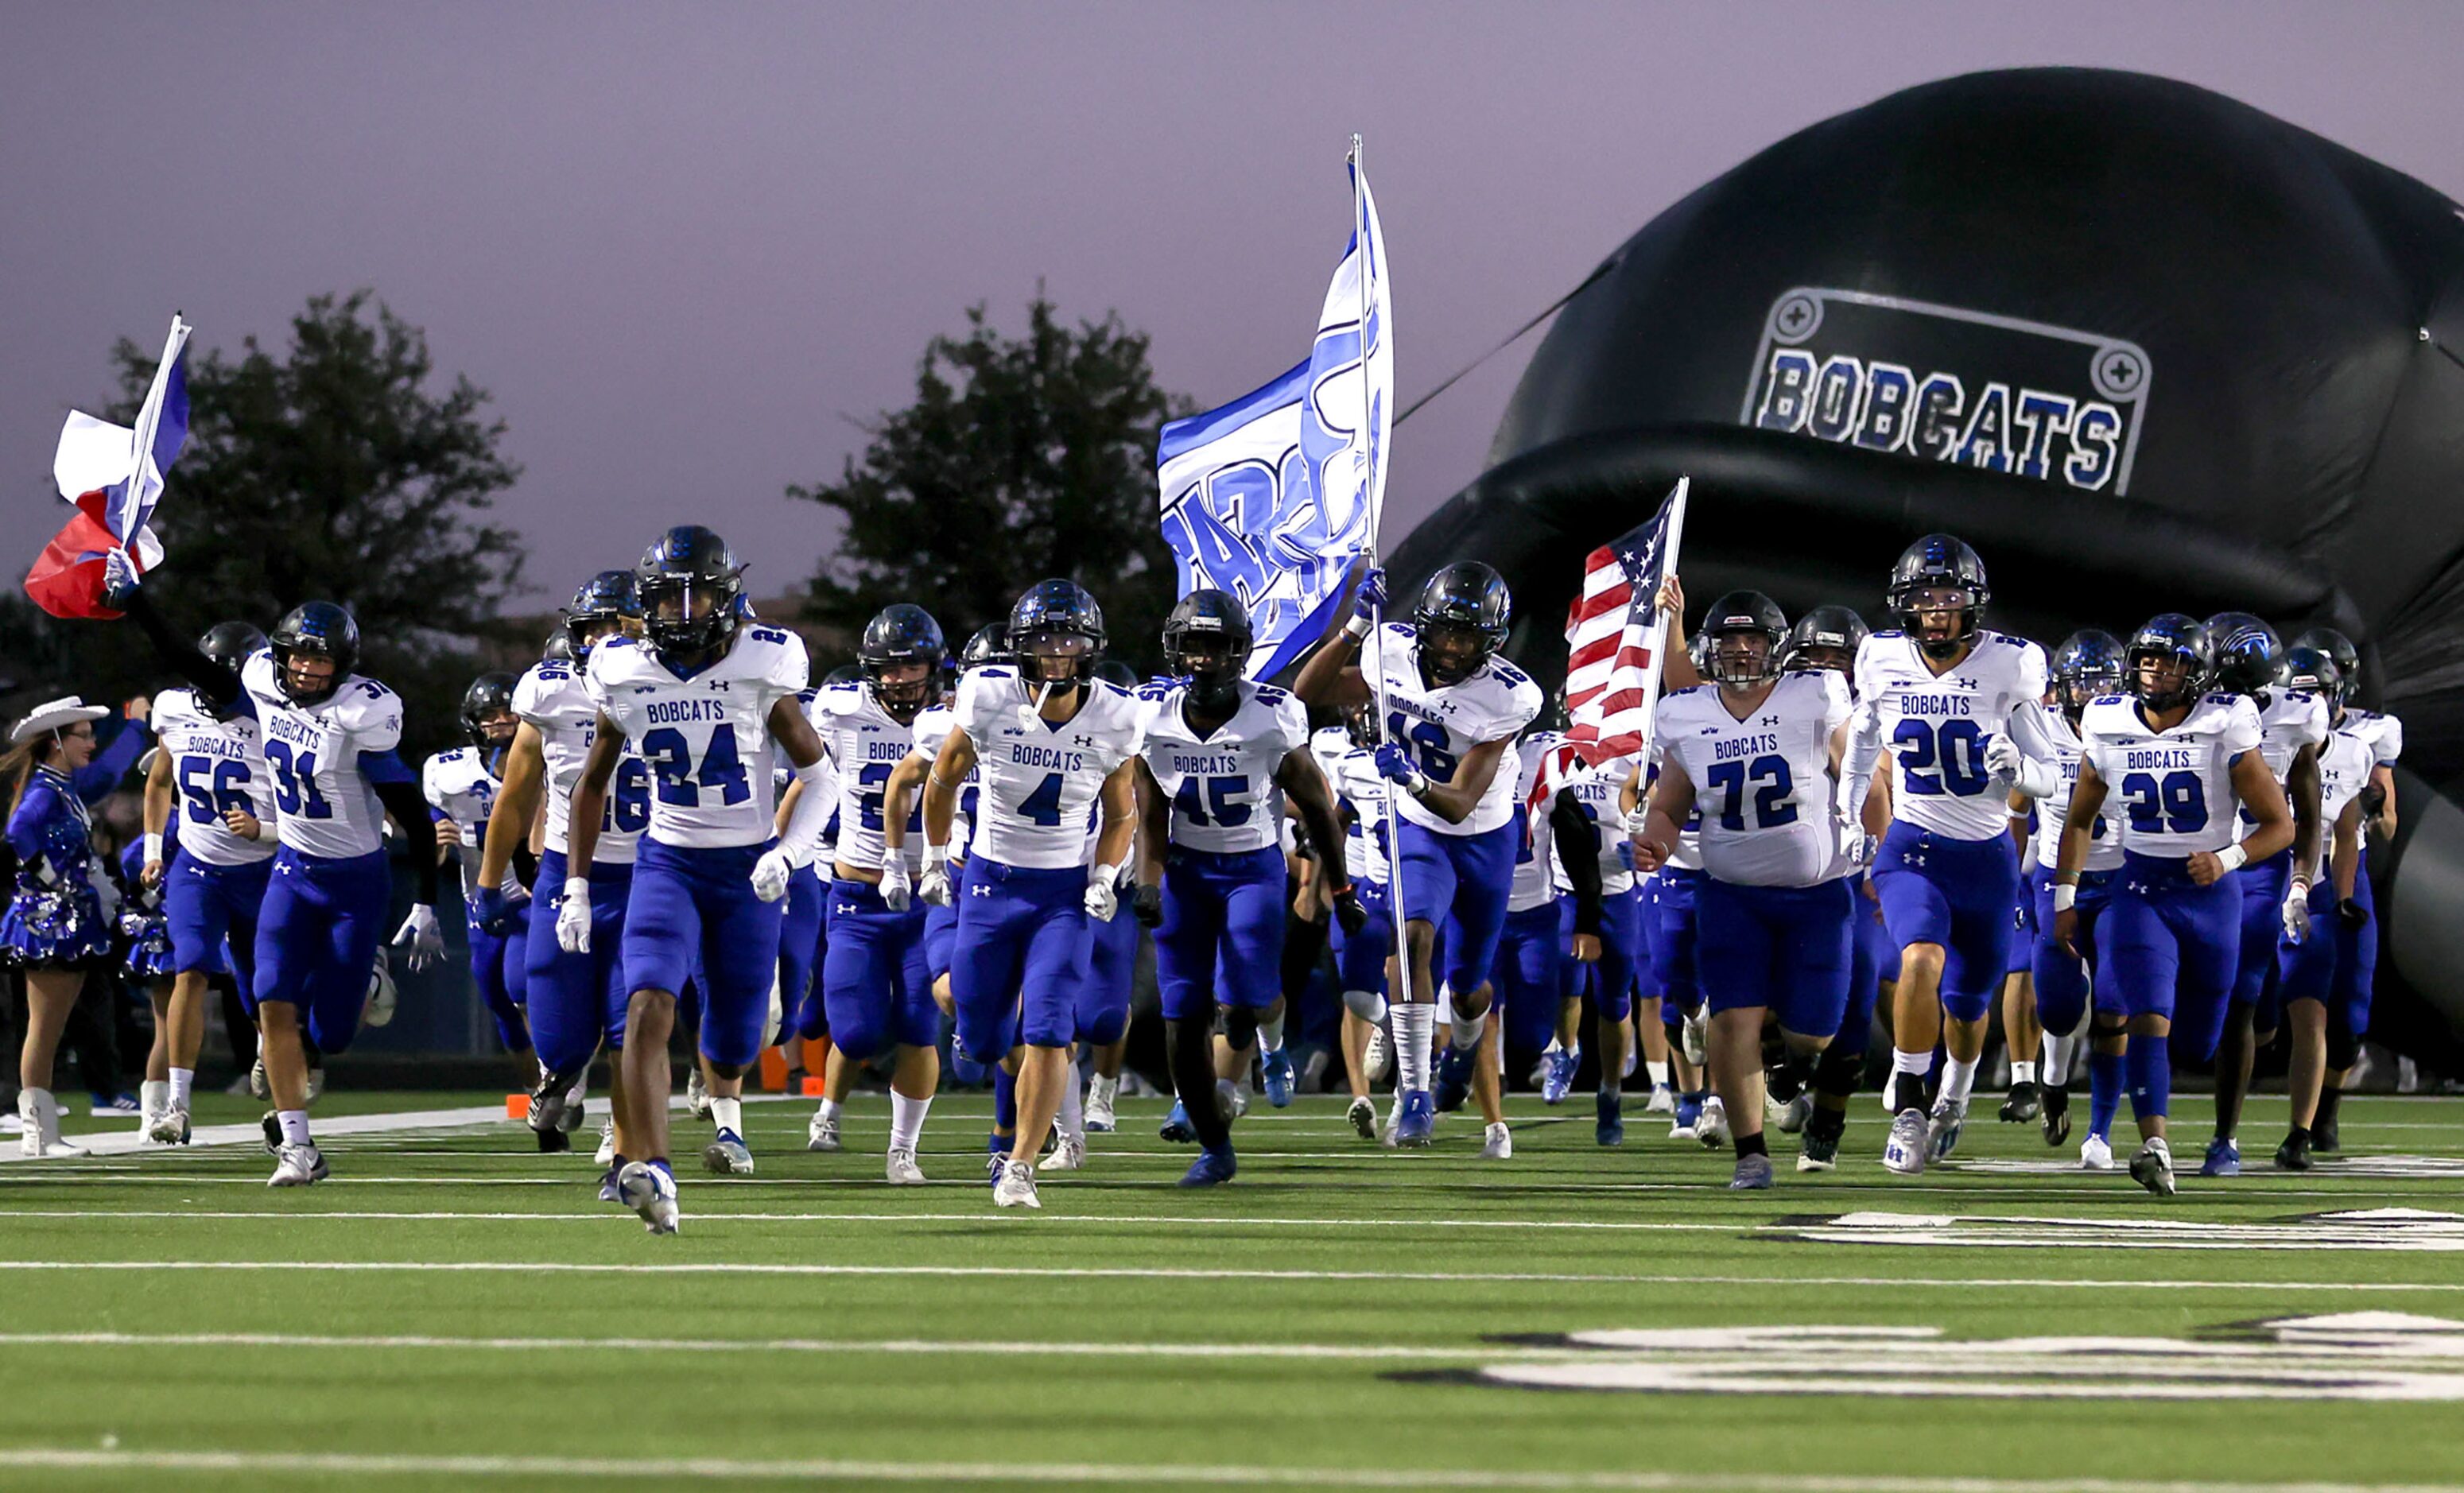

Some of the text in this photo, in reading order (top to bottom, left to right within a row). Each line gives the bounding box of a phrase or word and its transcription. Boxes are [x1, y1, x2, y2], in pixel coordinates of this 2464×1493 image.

[1756, 348, 2122, 491] BOBCATS
[647, 700, 724, 723] BOBCATS
[1901, 695, 1970, 715] BOBCATS
[188, 736, 245, 758] BOBCATS
[270, 715, 321, 749] BOBCATS
[1012, 744, 1082, 772] BOBCATS
[1387, 712, 1458, 784] 16
[1715, 733, 1778, 759] BOBCATS
[1893, 719, 1989, 797] 20
[264, 738, 332, 819] 31
[642, 723, 751, 808] 24
[1174, 756, 1236, 773] BOBCATS
[2128, 750, 2190, 770] BOBCATS
[180, 755, 257, 824] 56
[1017, 773, 1063, 826] 4
[1172, 775, 1252, 827] 45
[1707, 754, 1799, 831] 72
[2121, 770, 2209, 834] 29
